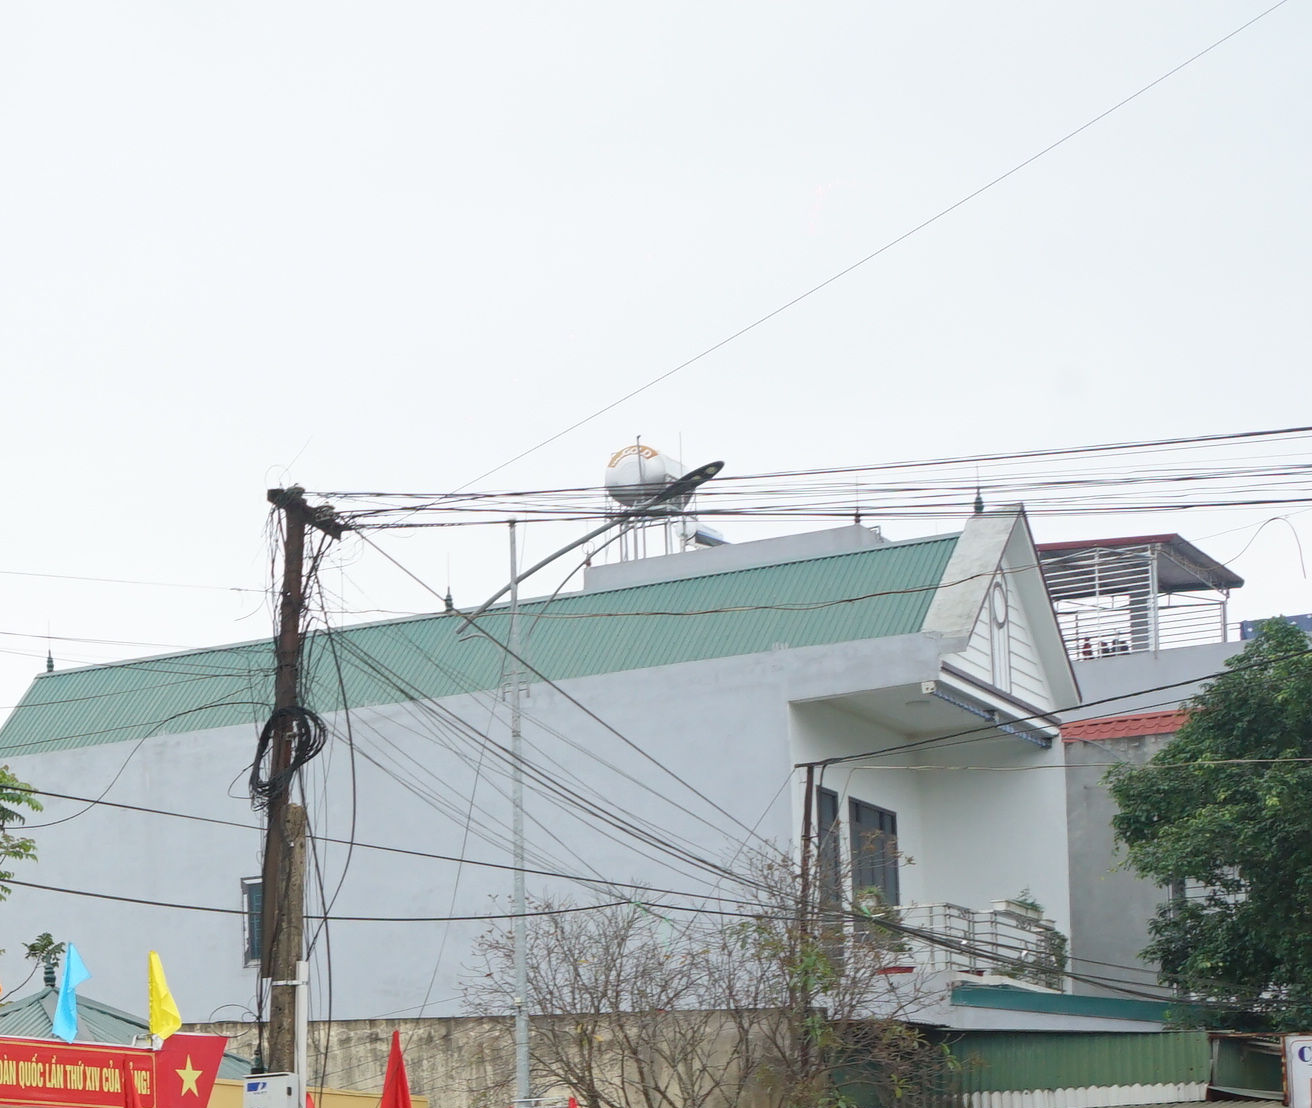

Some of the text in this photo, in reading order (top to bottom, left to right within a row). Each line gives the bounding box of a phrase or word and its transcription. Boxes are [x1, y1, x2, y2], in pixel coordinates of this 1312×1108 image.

[19, 1054, 43, 1088] QUỐC
[66, 1061, 84, 1090] THỨ
[86, 1066, 100, 1091] XIV
[102, 1060, 121, 1093] CỦA
